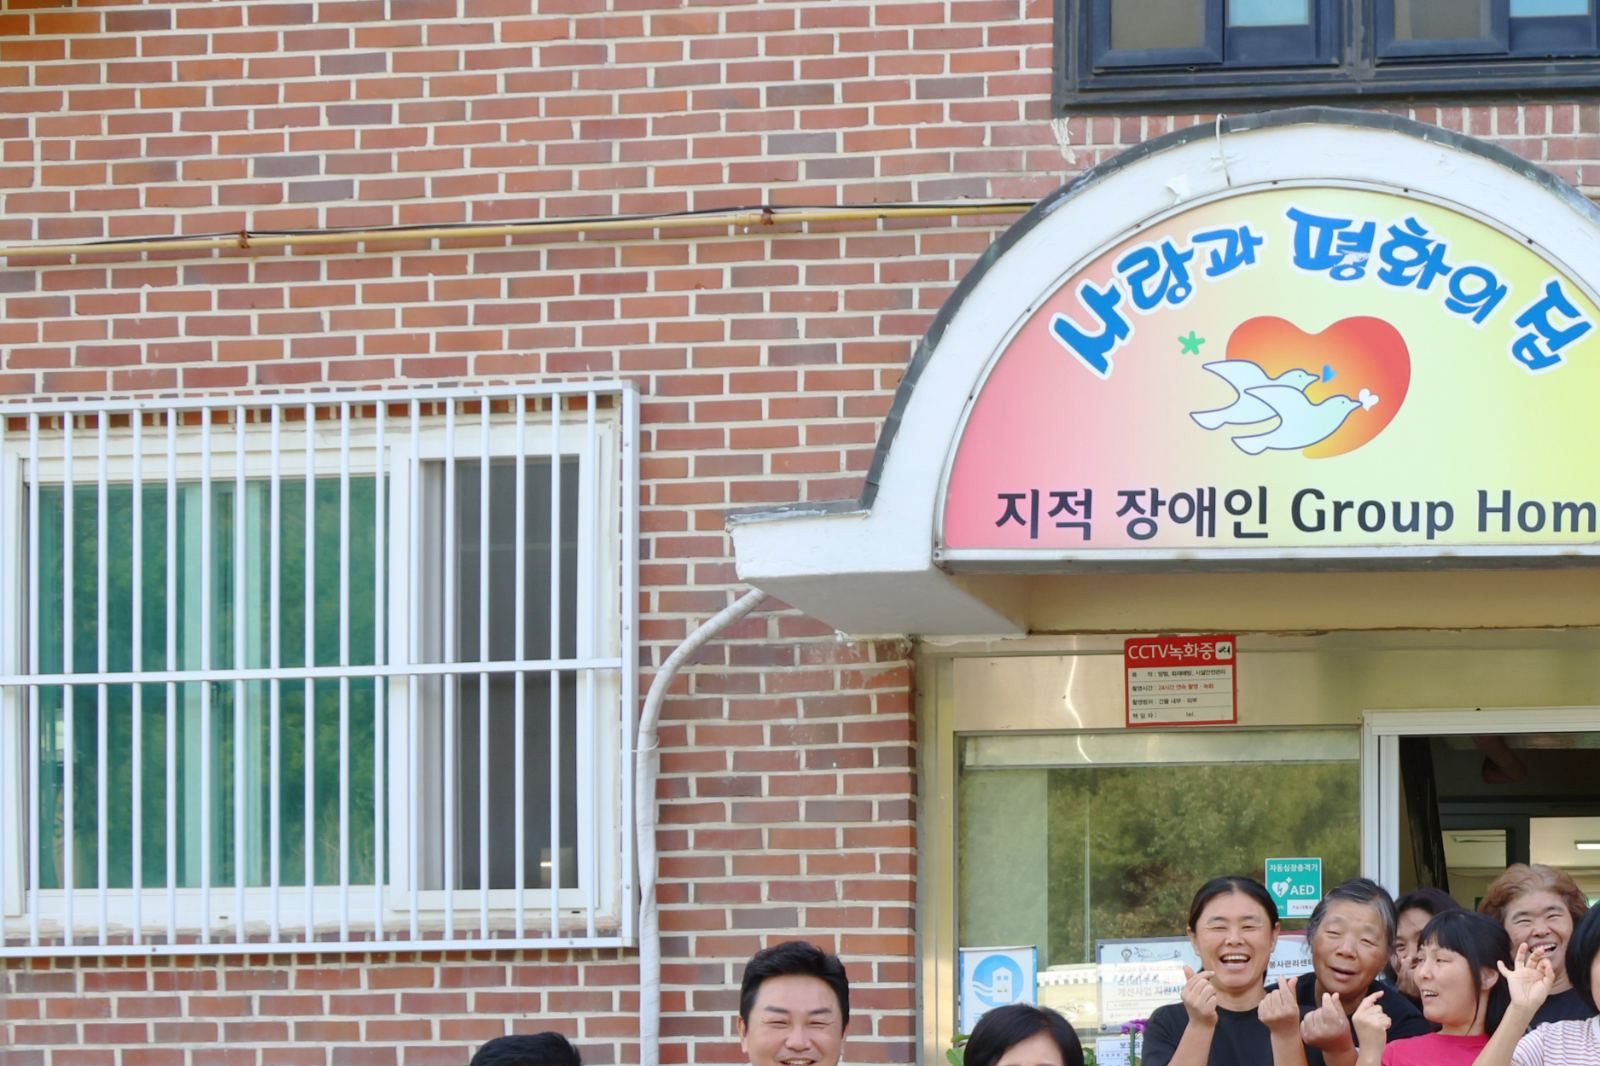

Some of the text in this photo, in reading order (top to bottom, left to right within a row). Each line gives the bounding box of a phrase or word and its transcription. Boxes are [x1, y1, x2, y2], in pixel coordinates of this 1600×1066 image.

[1053, 224, 1263, 375] 사랑과
[996, 488, 1093, 540] 지적
[1115, 486, 1269, 541] 장애인
[1291, 487, 1454, 540] Group
[1128, 642, 1215, 660] CCTV녹화중
[1269, 863, 1318, 873] 자동심장충격기
[1290, 885, 1316, 896] AED
